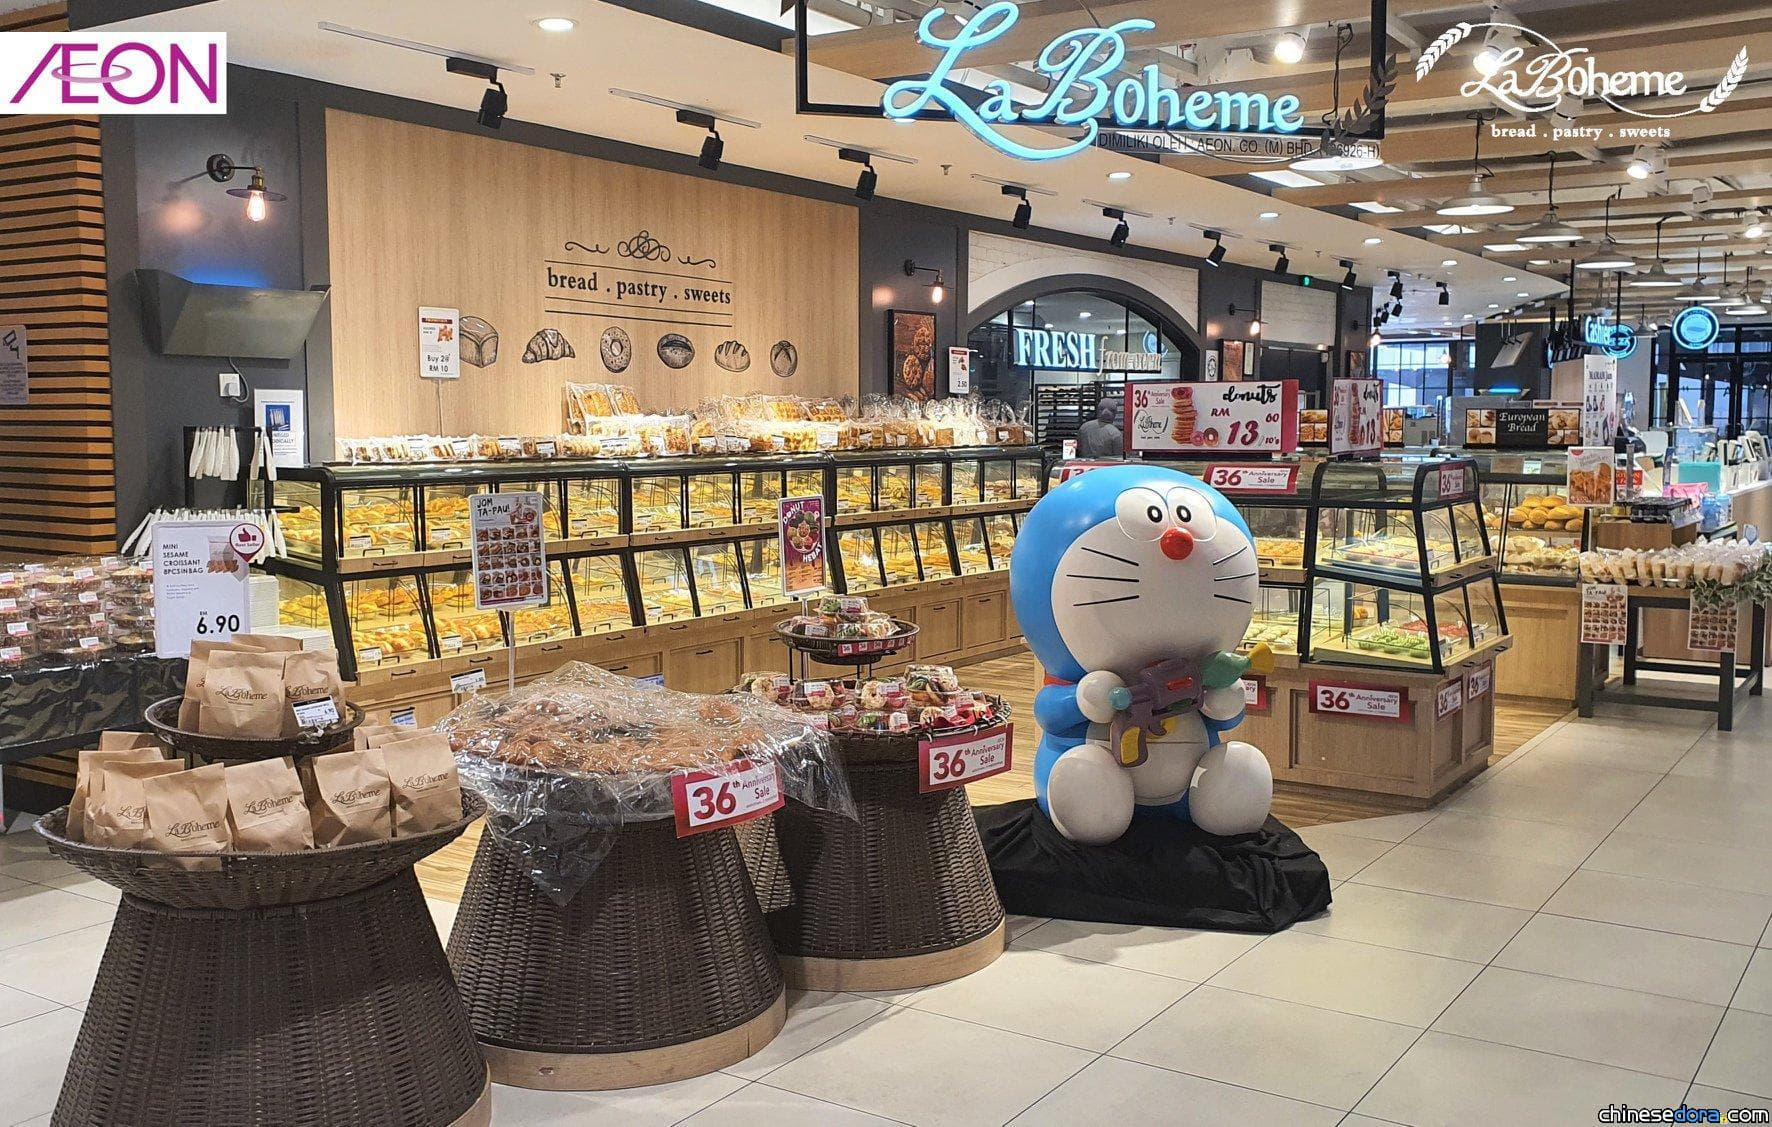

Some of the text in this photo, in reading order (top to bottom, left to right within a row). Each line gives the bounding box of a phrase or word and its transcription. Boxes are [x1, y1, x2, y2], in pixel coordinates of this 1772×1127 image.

[1022, 18, 1304, 134] Boheme
[1099, 132, 1148, 150] DIMILIKI
[547, 267, 732, 304] bread pastry sweets
[1014, 327, 1097, 369] FRESH
[1223, 384, 1281, 404] donuts
[1211, 408, 1230, 417] RM
[1499, 412, 1545, 425] European
[1227, 420, 1259, 446] 13
[1508, 421, 1538, 432] Bread
[477, 498, 493, 508] JOM
[783, 501, 805, 525] DONUT
[197, 614, 240, 635] 6.90
[1356, 694, 1398, 705] Anniversary
[1367, 702, 1386, 711] Sale
[971, 743, 1005, 757] Anniversary
[980, 753, 995, 766] Sale
[755, 786, 770, 799] Sale
